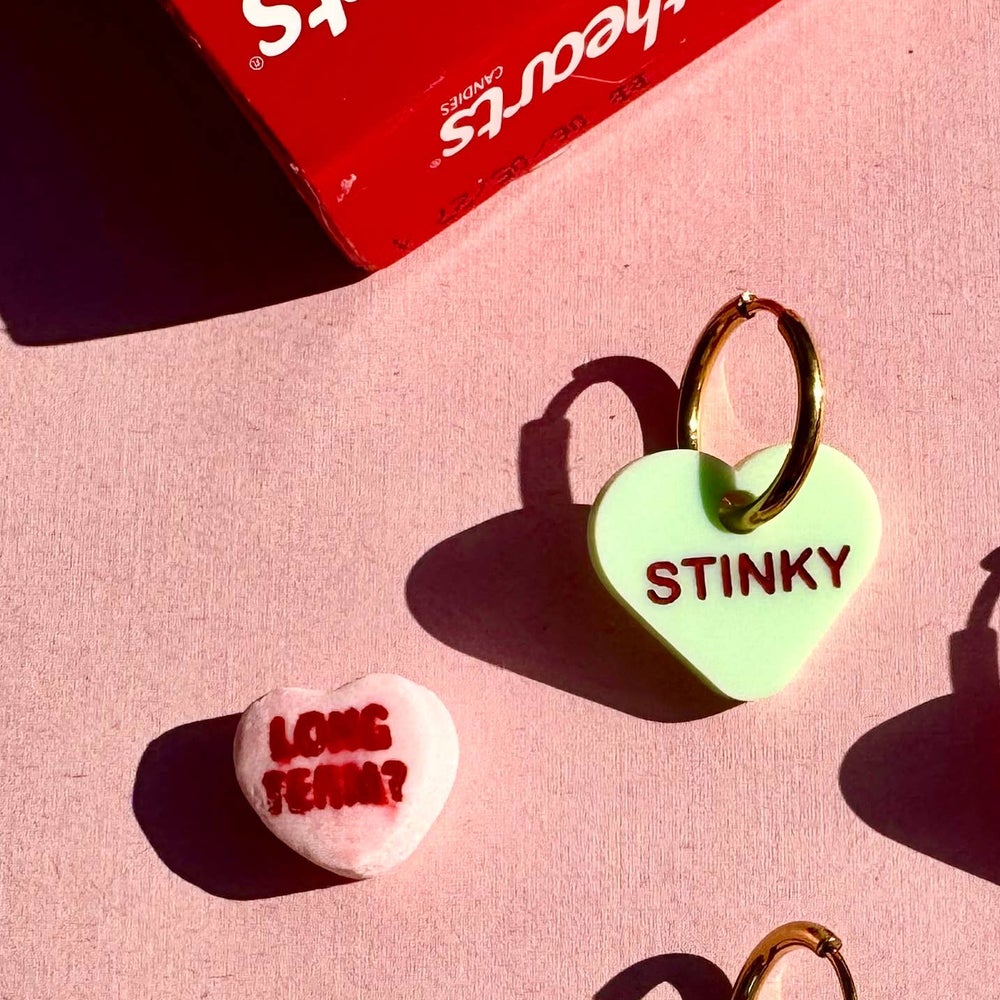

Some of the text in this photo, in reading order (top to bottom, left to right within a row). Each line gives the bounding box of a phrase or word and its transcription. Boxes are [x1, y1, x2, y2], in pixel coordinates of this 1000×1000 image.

[439, 0, 686, 158] hearts
[440, 65, 504, 116] CANDIES
[645, 544, 851, 606] STINKY
[269, 703, 393, 764] LONG
